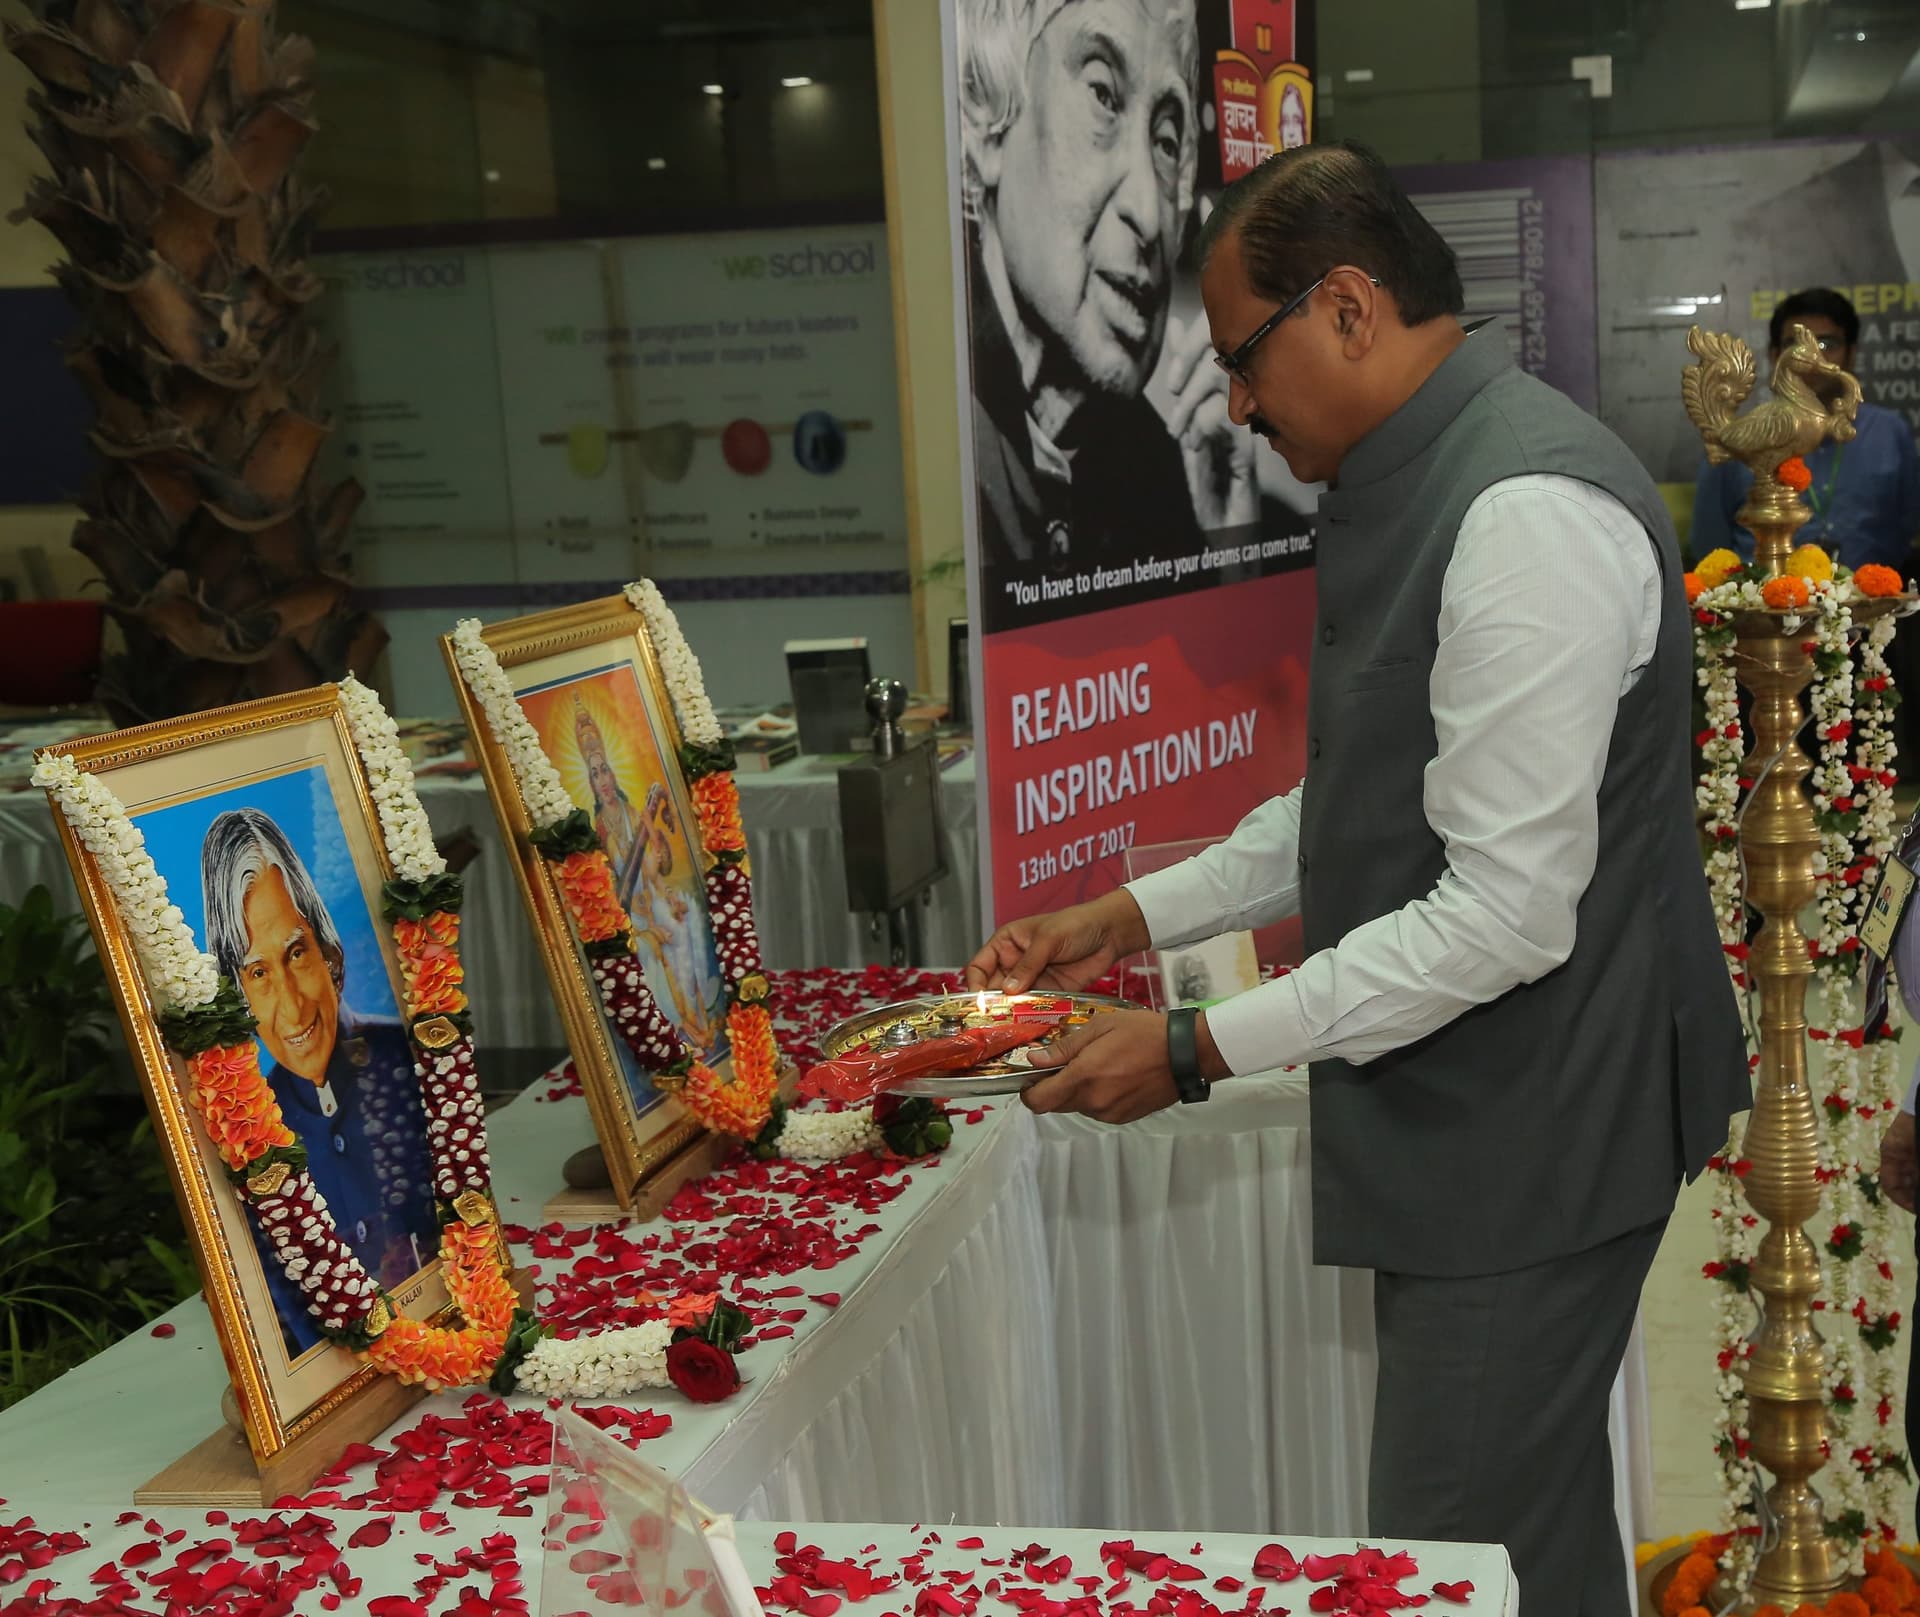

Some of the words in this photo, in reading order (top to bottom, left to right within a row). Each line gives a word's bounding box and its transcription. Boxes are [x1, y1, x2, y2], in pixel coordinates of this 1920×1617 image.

[1042, 575, 1073, 600] have
[1076, 572, 1090, 594] to
[1092, 565, 1133, 590] dream
[1133, 555, 1172, 583] before
[1174, 553, 1200, 582] your
[1201, 546, 1241, 570] dreams
[1242, 543, 1260, 562] can
[1262, 537, 1288, 558] come
[1011, 661, 1151, 748] READING
[1015, 723, 1201, 836] INSPIRATION
[1208, 708, 1258, 768] DAY
[1017, 855, 1057, 889] 13th
[1060, 838, 1095, 869] OCT
[1099, 821, 1137, 859] 2017
